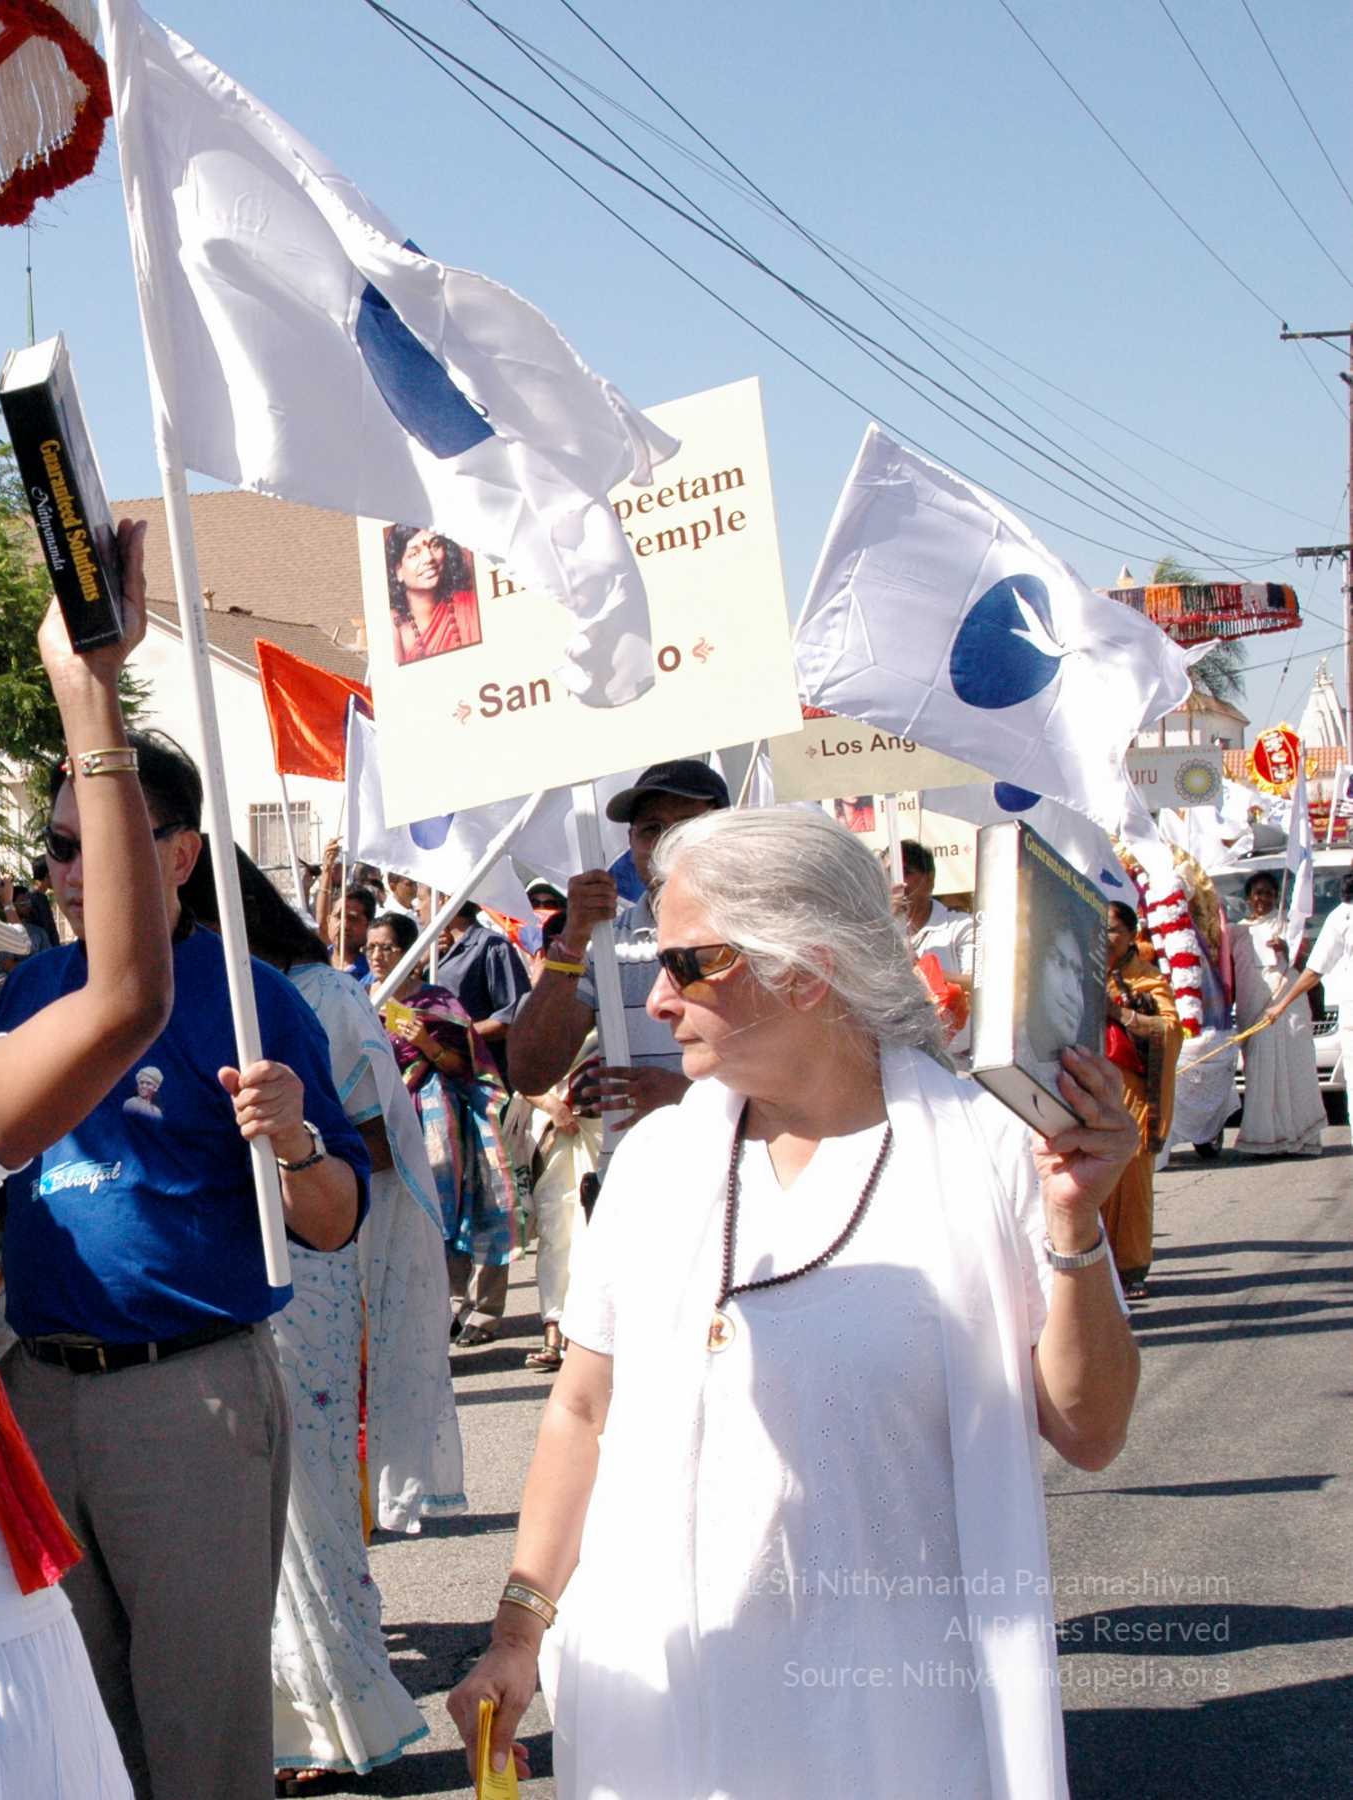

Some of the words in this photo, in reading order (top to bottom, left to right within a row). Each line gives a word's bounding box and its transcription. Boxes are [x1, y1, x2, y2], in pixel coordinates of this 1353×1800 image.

[613, 466, 746, 522] peetam
[40, 440, 82, 529] Guaranteed
[66, 528, 100, 603] Solutions
[623, 505, 747, 557] emple
[478, 676, 551, 719] San
[821, 738, 863, 757] Los
[870, 733, 917, 753] Ang
[1128, 767, 1158, 785] uru
